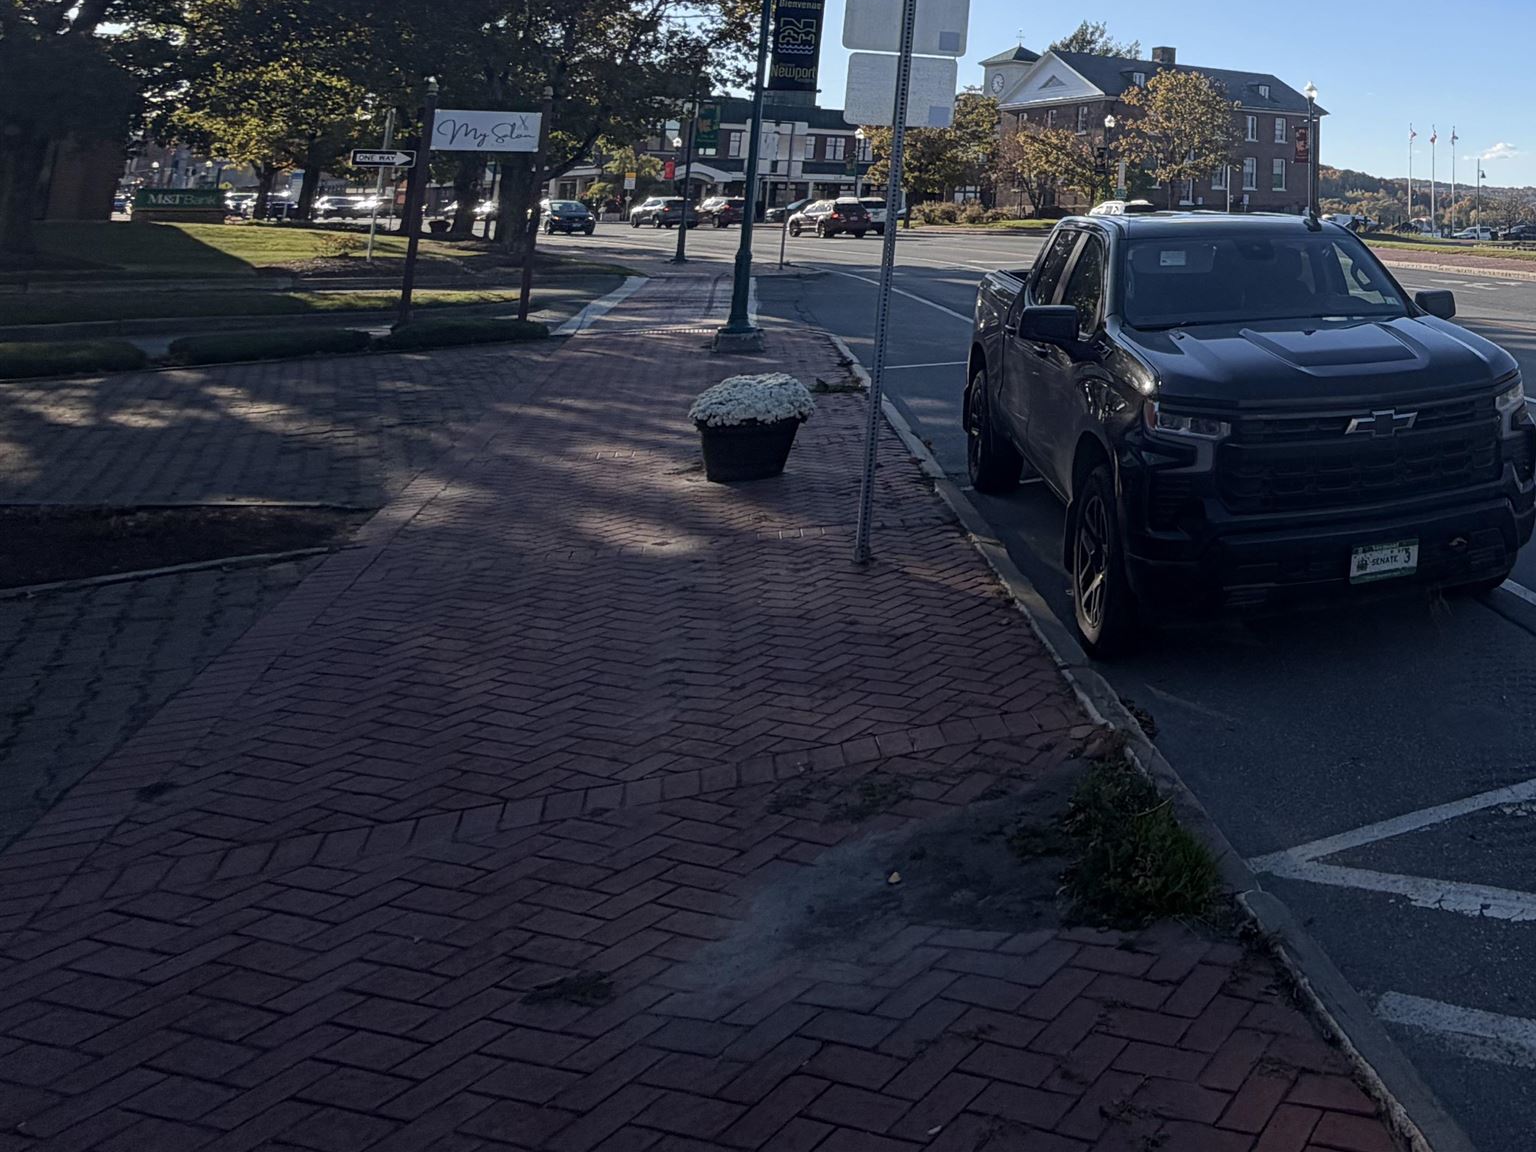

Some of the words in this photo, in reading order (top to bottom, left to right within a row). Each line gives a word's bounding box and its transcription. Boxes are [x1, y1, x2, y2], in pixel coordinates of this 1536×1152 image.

[771, 63, 816, 80] Newport
[436, 119, 489, 147] My
[491, 122, 536, 144] Salon
[358, 154, 375, 162] ONE
[378, 154, 396, 162] WAY
[147, 193, 183, 205] M&T
[183, 194, 217, 205] Bank
[1371, 555, 1399, 566] SENATE
